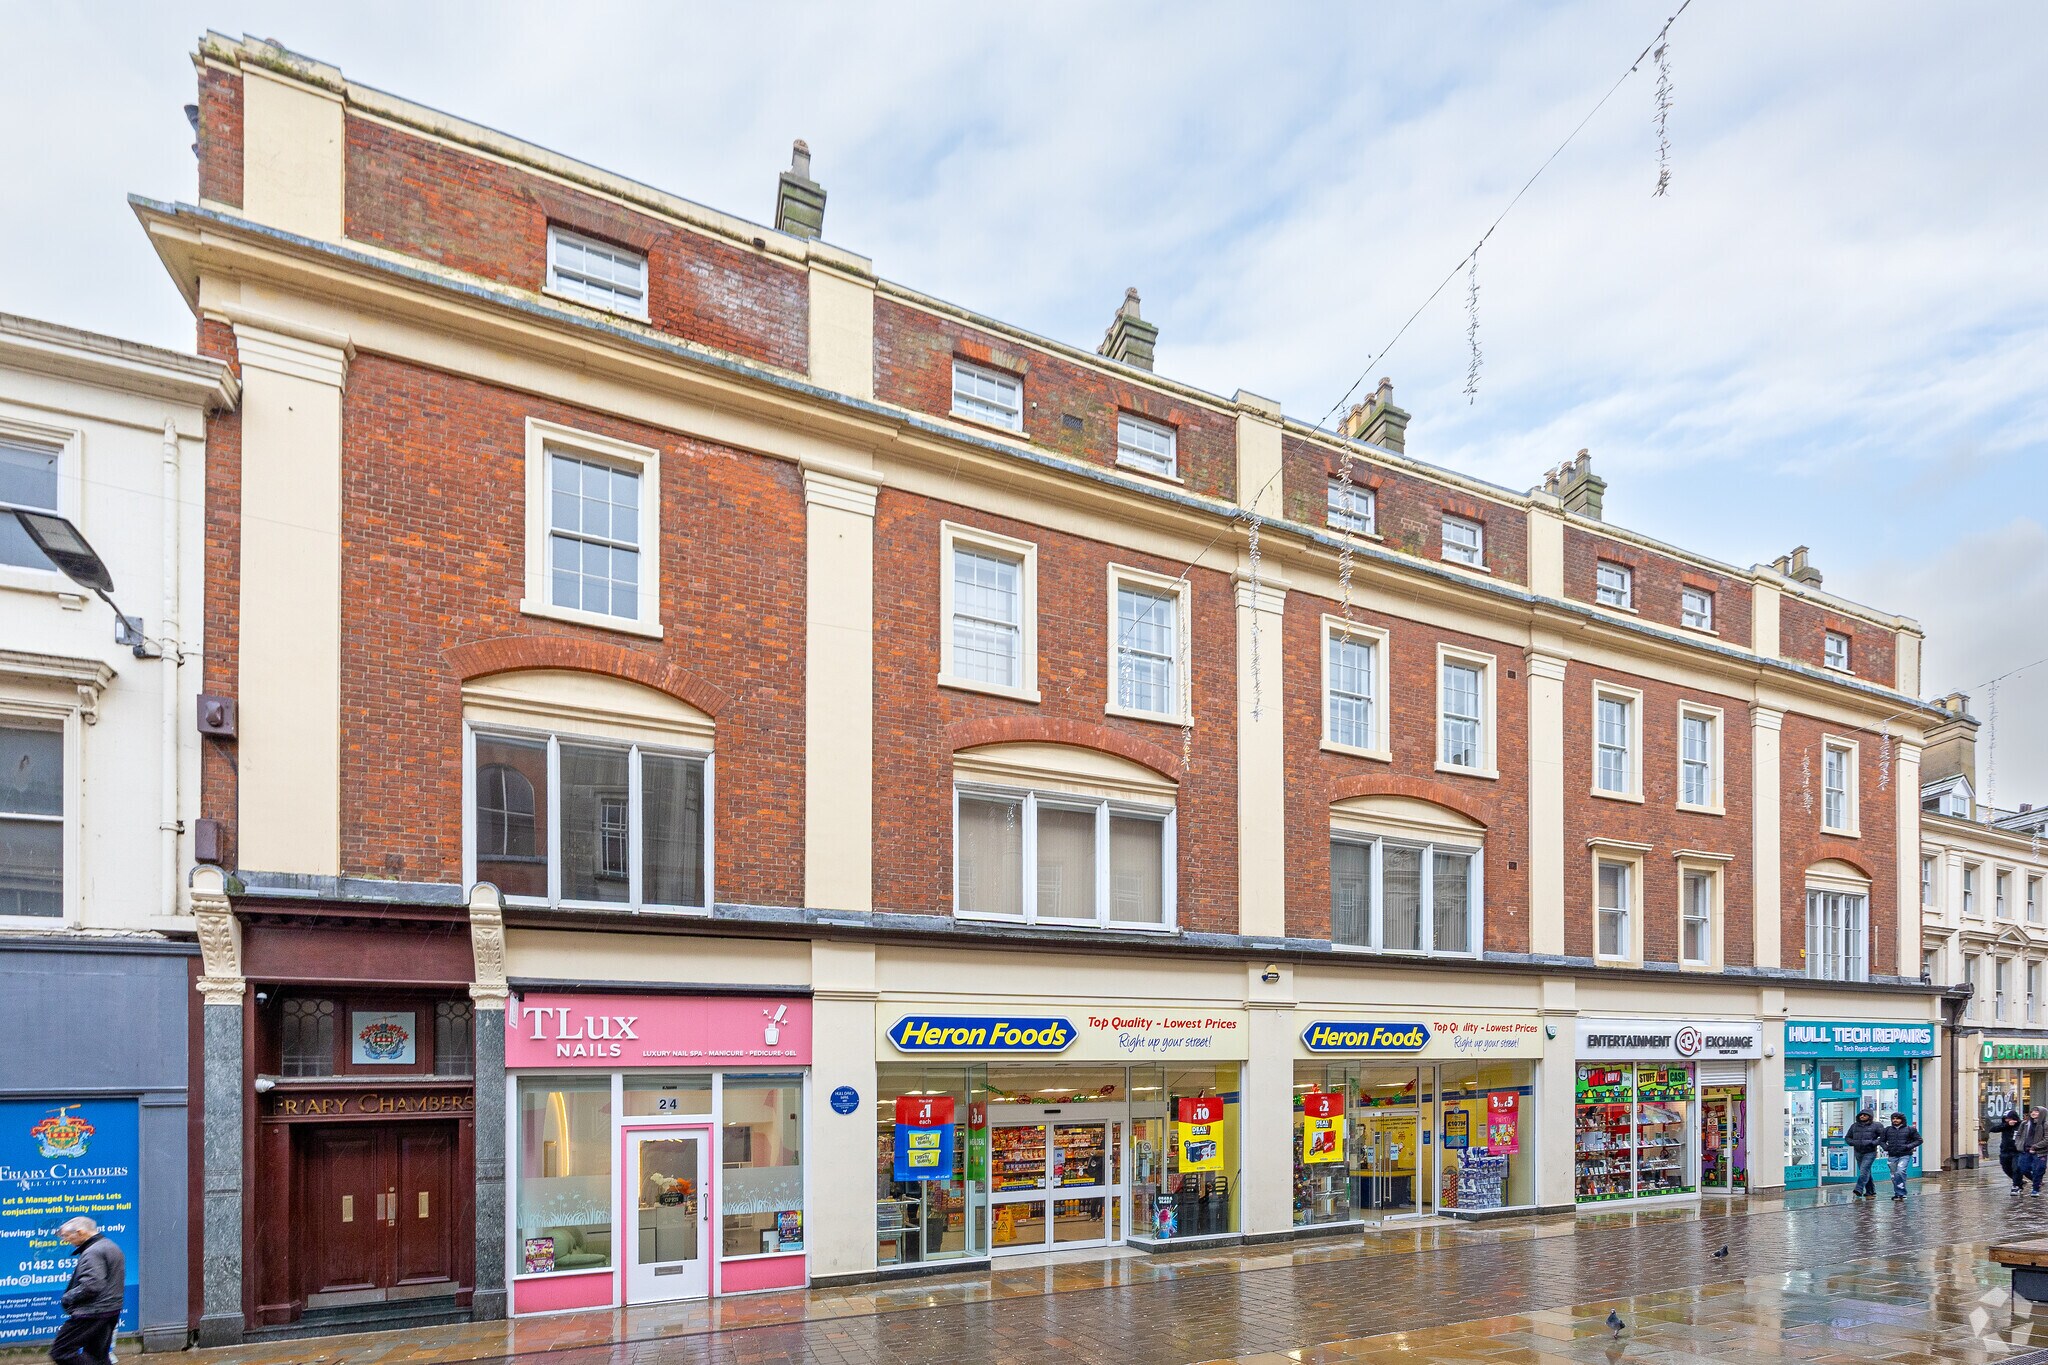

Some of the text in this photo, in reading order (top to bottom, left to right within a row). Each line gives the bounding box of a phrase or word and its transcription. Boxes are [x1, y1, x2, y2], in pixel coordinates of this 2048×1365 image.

[1088, 1016, 1109, 1030] Top
[1111, 1017, 1153, 1031] Quality
[1164, 1018, 1202, 1028] Lowest
[1205, 1018, 1237, 1029] Prices
[1433, 1022, 1448, 1033] Top
[1486, 1023, 1513, 1032] Lowest
[1515, 1024, 1538, 1033] Prices
[900, 1021, 1067, 1046] Heron Foods
[1311, 1026, 1424, 1047] Heron Foods
[1788, 1026, 1931, 1043] HULL TECH REPAIRS
[1119, 1032, 1212, 1053] Right up your street!
[1454, 1035, 1472, 1052] Right
[1474, 1041, 1482, 1051] up
[1484, 1040, 1499, 1052] your
[1588, 1035, 1671, 1047] ENTERTAINMENT
[1705, 1036, 1753, 1048] EXCHANGE
[556, 1043, 622, 1057] NAILS
[1855, 1045, 1868, 1053] Repair
[1639, 1072, 1656, 1083] STUFF
[1670, 1071, 1686, 1083] CASH
[358, 1093, 474, 1113] CHAMBERS
[659, 1098, 677, 1110] 24
[1492, 1096, 1498, 1107] 3
[919, 1103, 932, 1118] £1
[1193, 1107, 1210, 1120] £10
[0, 1163, 128, 1181] FRIARY CHAMBERS
[2, 1197, 15, 1205] Let
[25, 1195, 62, 1205] Managed
[64, 1194, 74, 1203] by
[76, 1193, 104, 1201] Larards
[106, 1192, 121, 1200] Lets
[2, 1206, 43, 1217] conjuction
[65, 1204, 89, 1213] Trinity
[91, 1203, 114, 1211] House
[116, 1202, 132, 1210] Hull
[38, 1227, 49, 1237] by
[107, 1223, 126, 1233] only
[29, 1239, 57, 1248] Please
[19, 1260, 55, 1271] 01482
